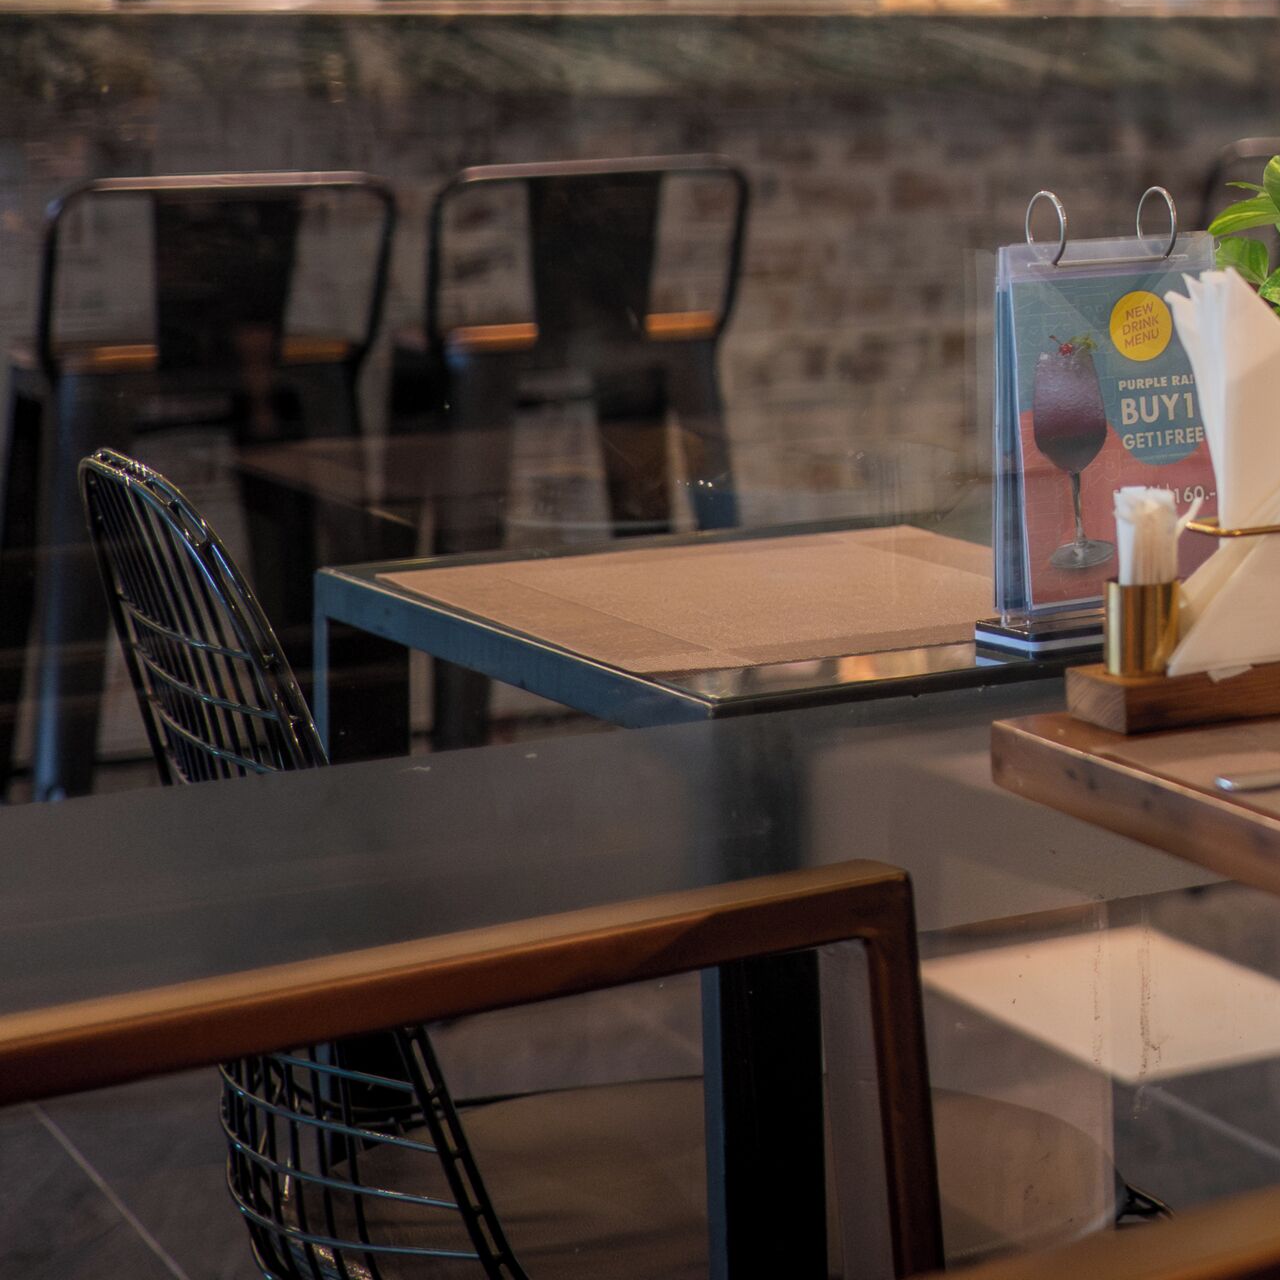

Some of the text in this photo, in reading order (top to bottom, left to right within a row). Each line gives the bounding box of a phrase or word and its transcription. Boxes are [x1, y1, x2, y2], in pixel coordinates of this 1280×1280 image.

[1125, 302, 1154, 320] NEW
[1122, 314, 1160, 335] DRINK
[1124, 328, 1160, 349] MENU
[1118, 374, 1196, 391] PURPLE RAI
